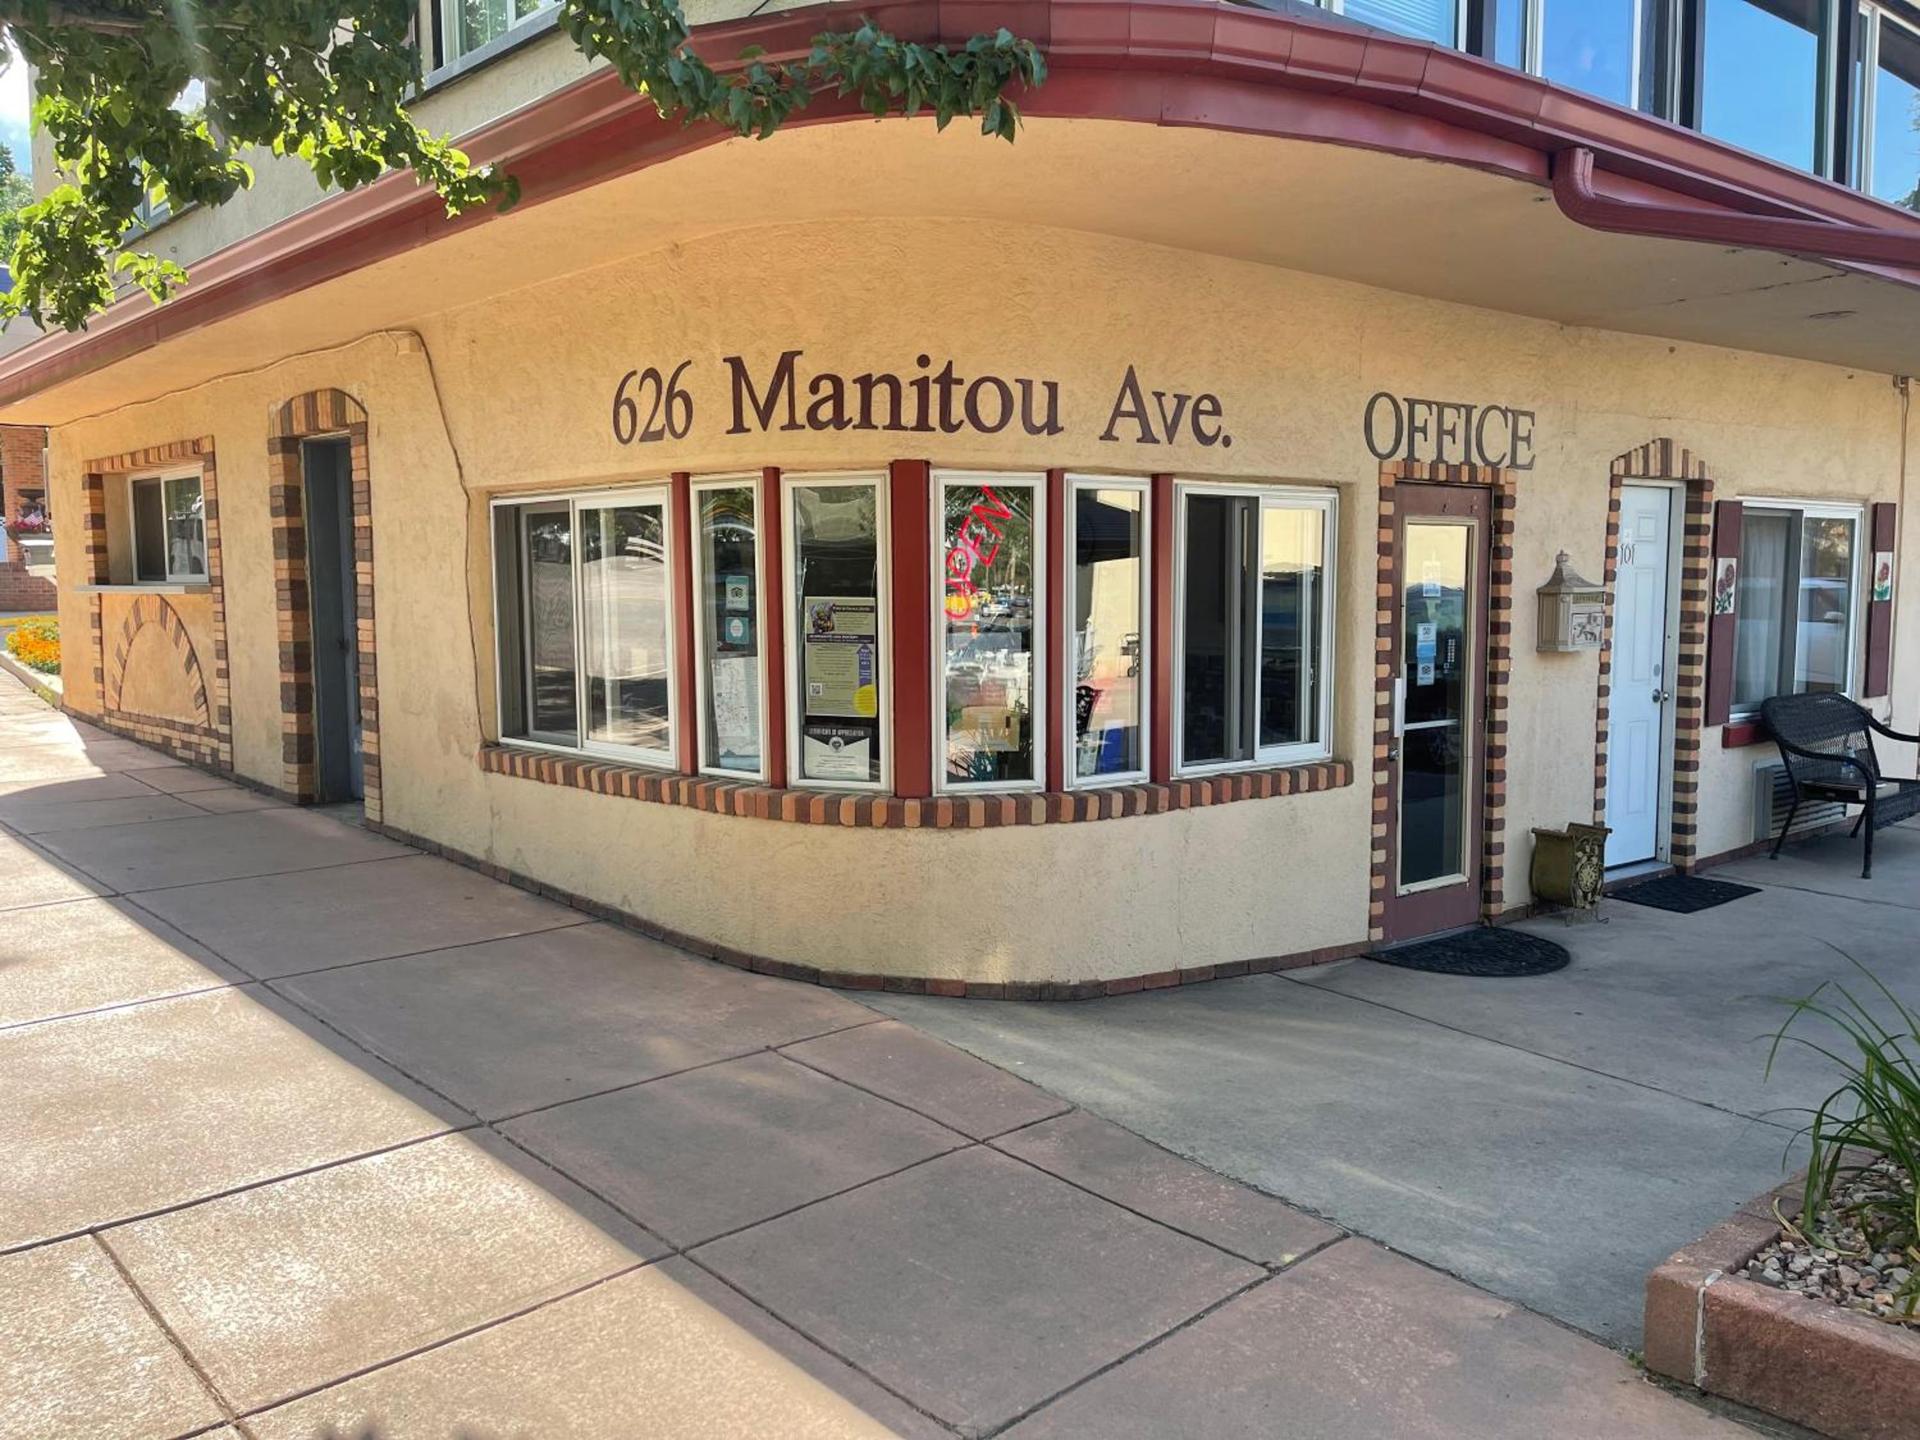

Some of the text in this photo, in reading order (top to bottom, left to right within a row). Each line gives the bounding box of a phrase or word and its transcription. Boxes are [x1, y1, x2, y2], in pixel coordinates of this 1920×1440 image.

[612, 350, 1233, 448] 626 Manitou Ave.
[1364, 391, 1536, 471] OFFICE
[944, 484, 1012, 619] OPEN
[1620, 543, 1636, 566] 101
